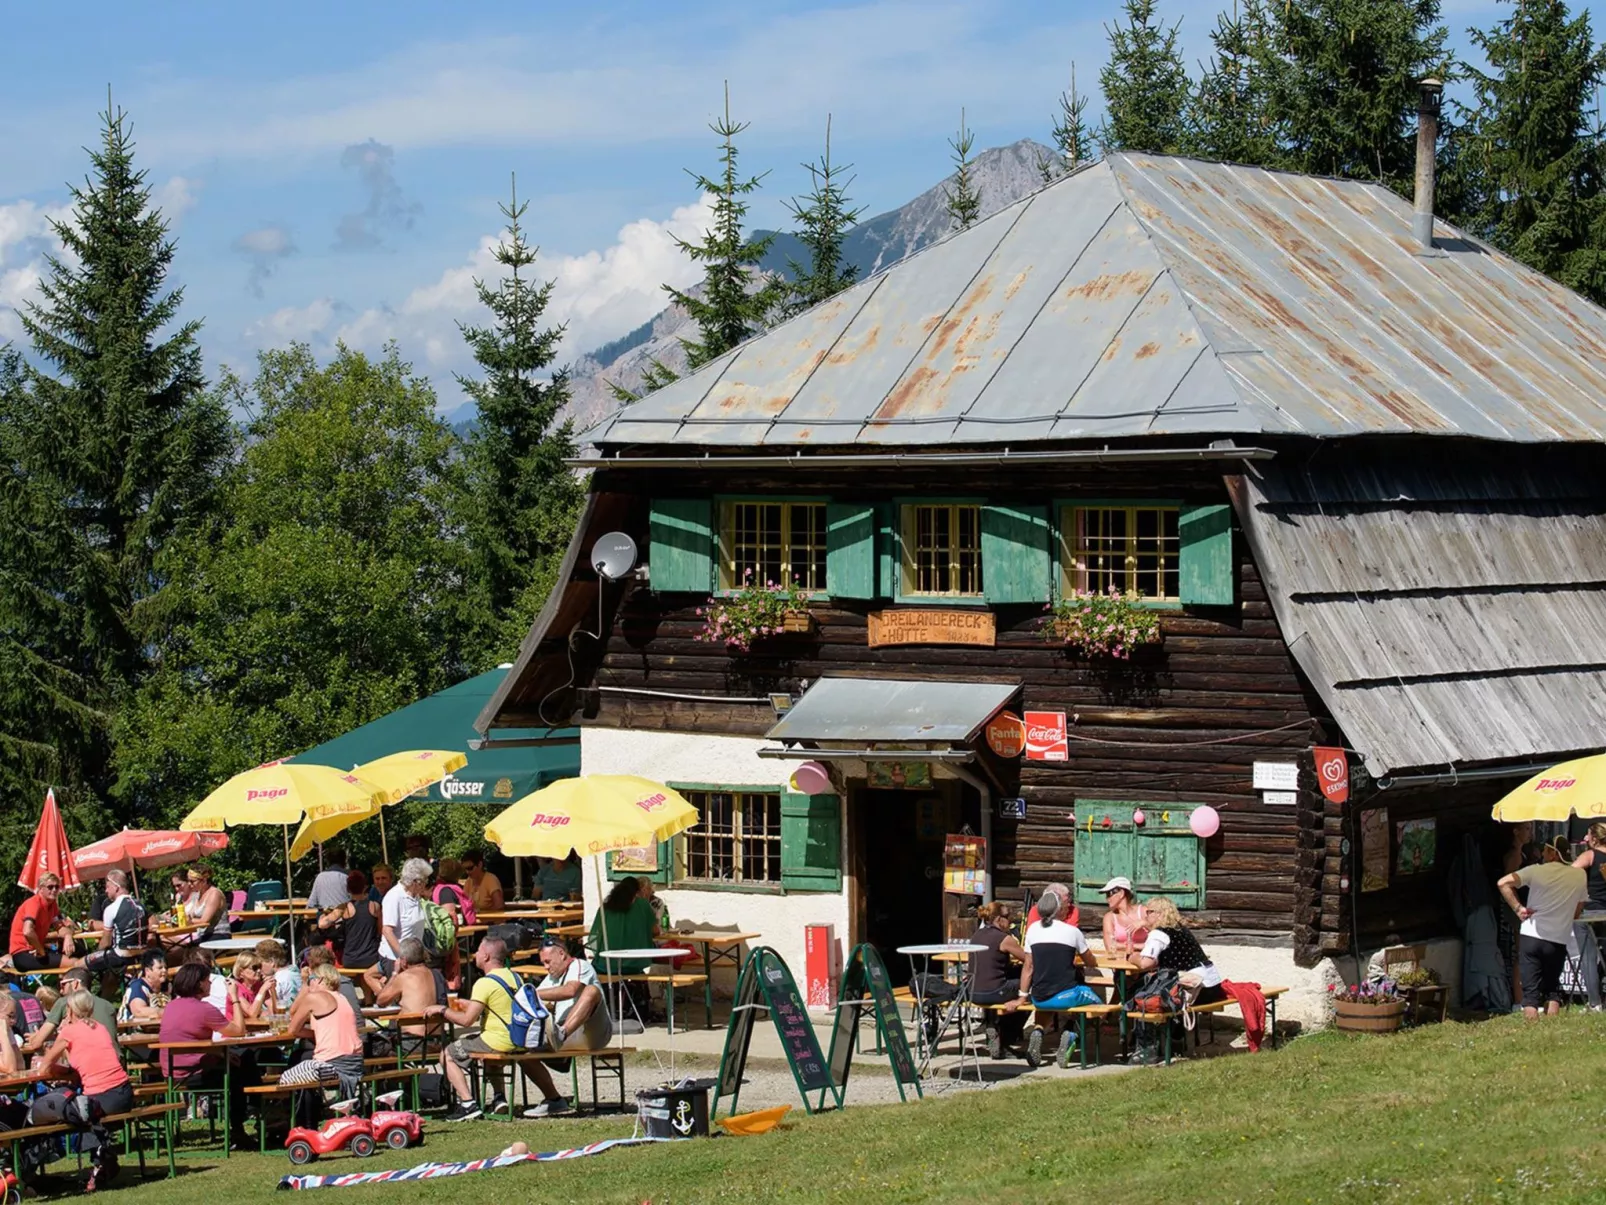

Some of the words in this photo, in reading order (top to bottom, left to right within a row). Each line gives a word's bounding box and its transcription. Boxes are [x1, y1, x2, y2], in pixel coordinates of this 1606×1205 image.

[990, 727, 1021, 740] Fanta
[440, 774, 485, 799] Gösser
[1534, 778, 1576, 792] pago
[247, 787, 288, 801] pago
[636, 793, 667, 812] pago
[1003, 800, 1020, 811] 72
[531, 813, 571, 827] pago
